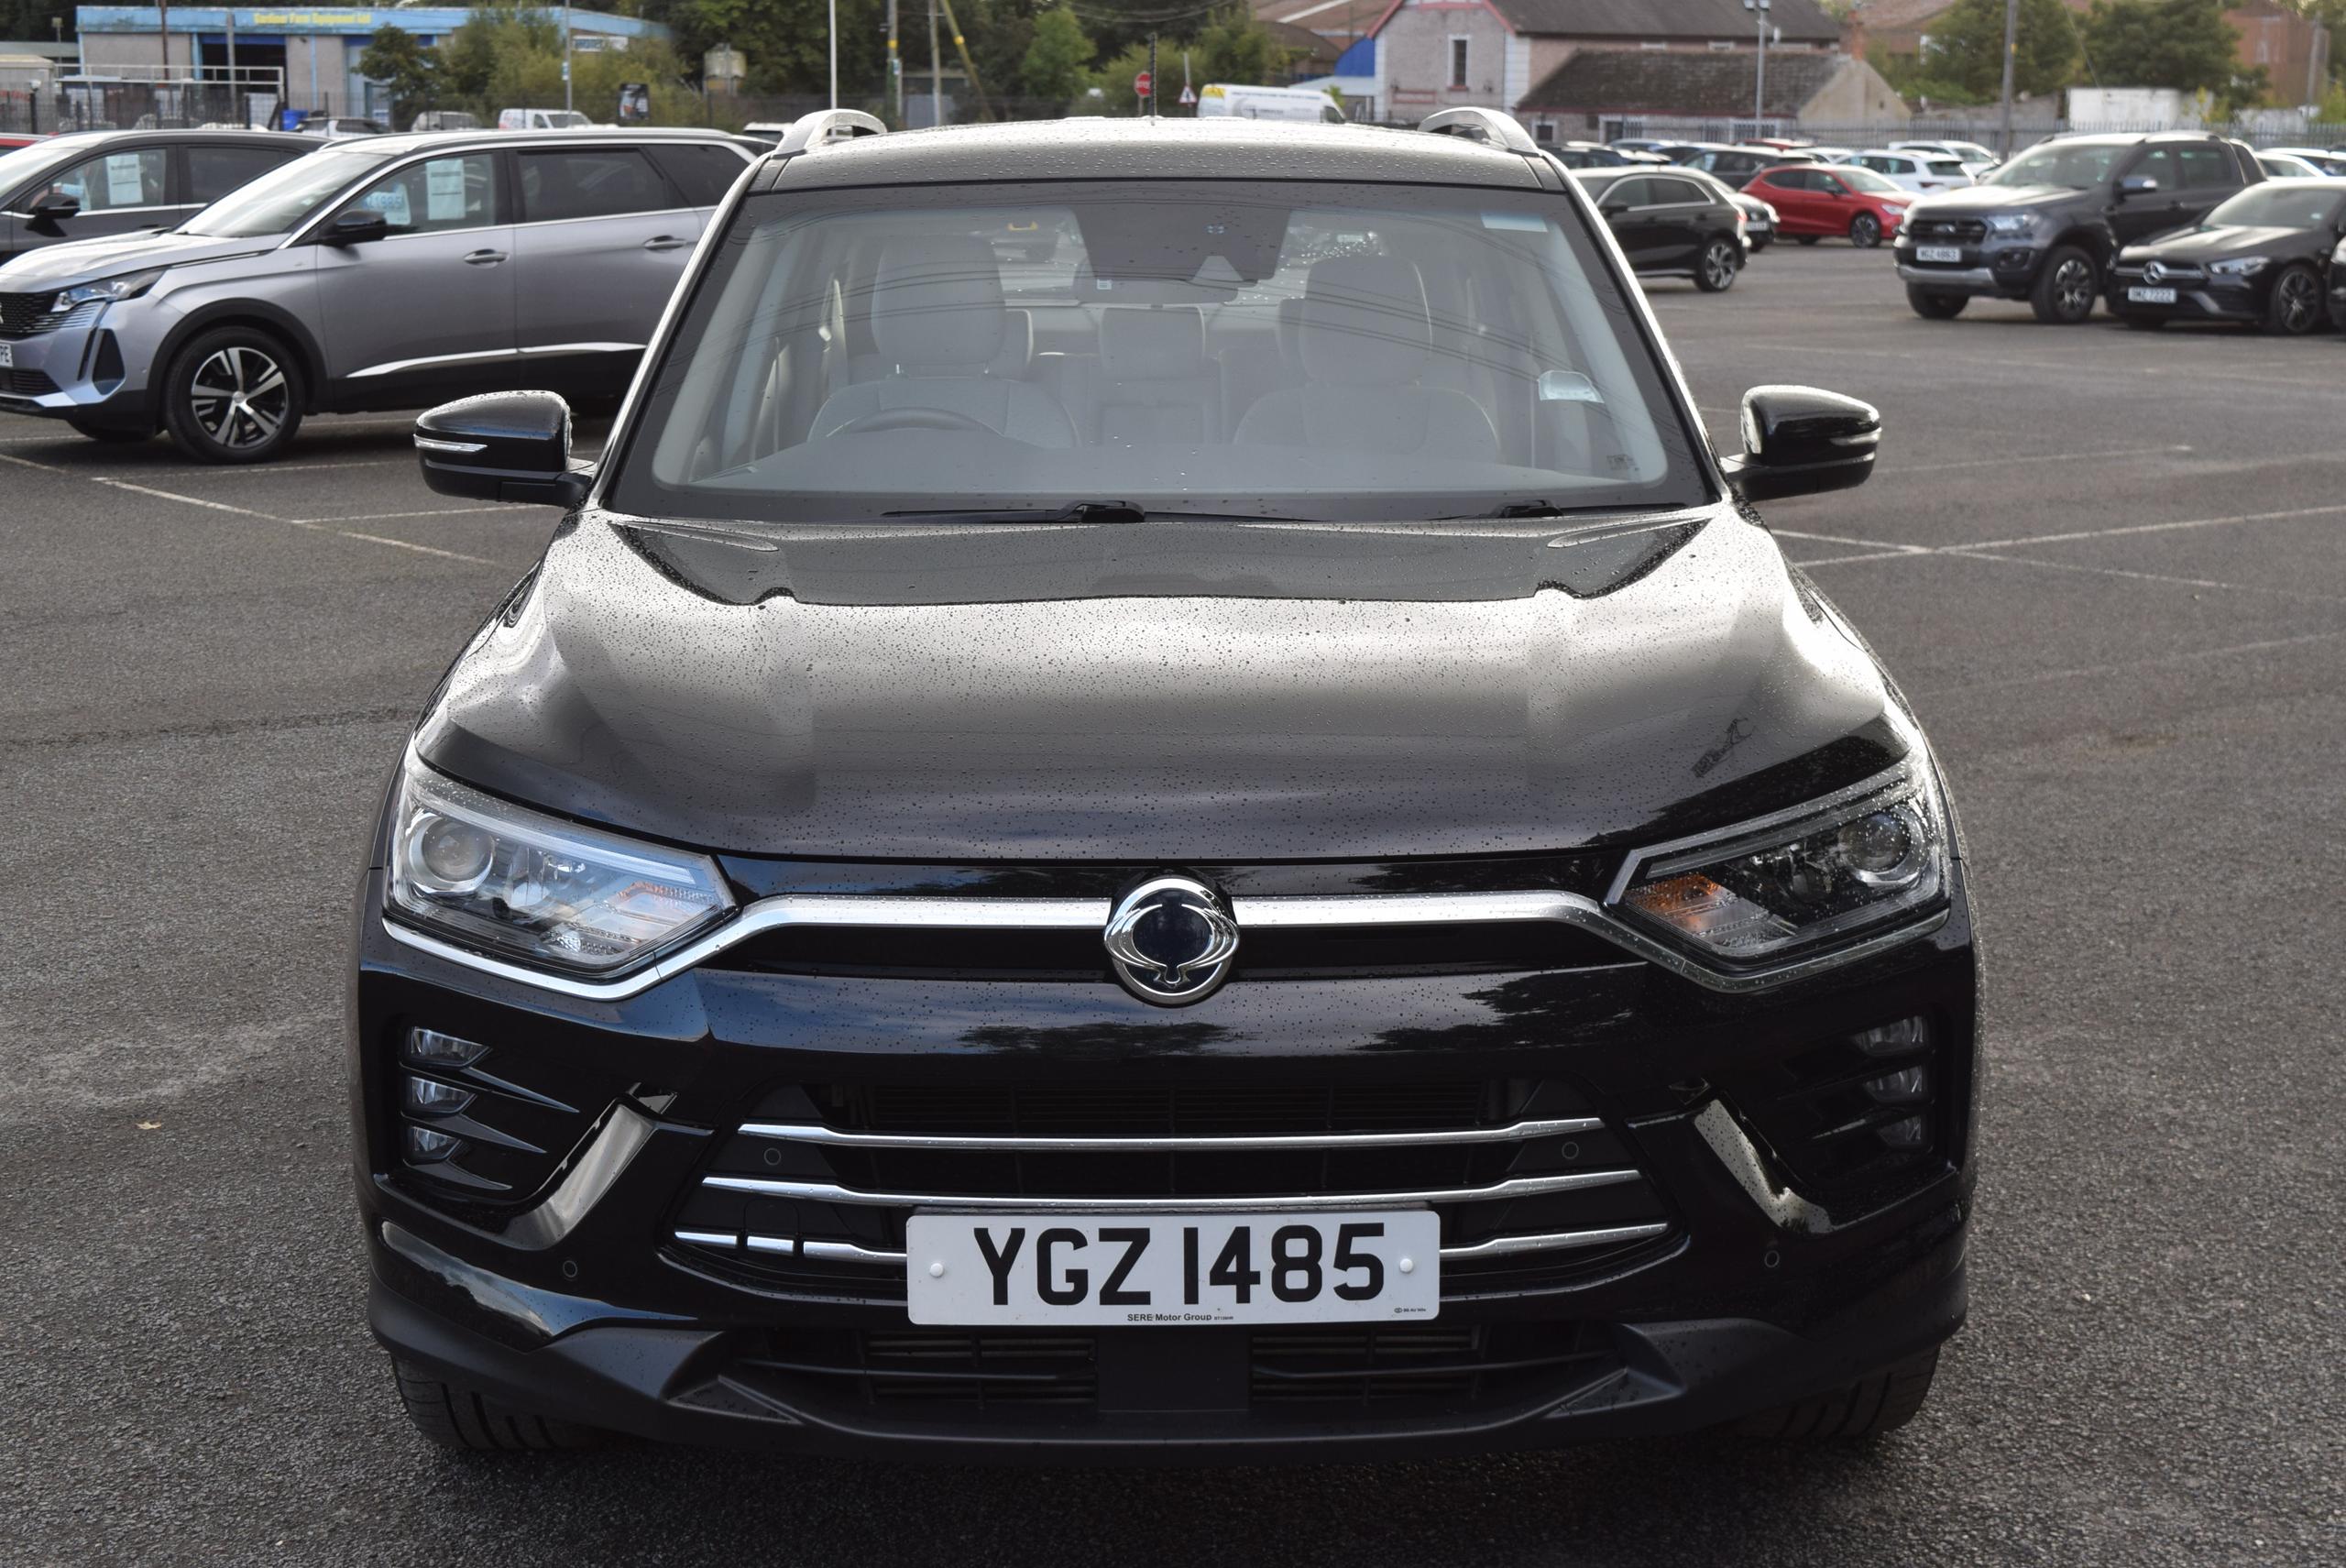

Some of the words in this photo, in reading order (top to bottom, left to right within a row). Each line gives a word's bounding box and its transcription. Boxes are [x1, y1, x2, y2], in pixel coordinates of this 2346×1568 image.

[974, 1227, 1151, 1306] YGZ
[1183, 1223, 1385, 1305] 1485
[1127, 1313, 1153, 1321] SERE
[1155, 1313, 1181, 1321] Motor
[1183, 1312, 1212, 1321] Group
